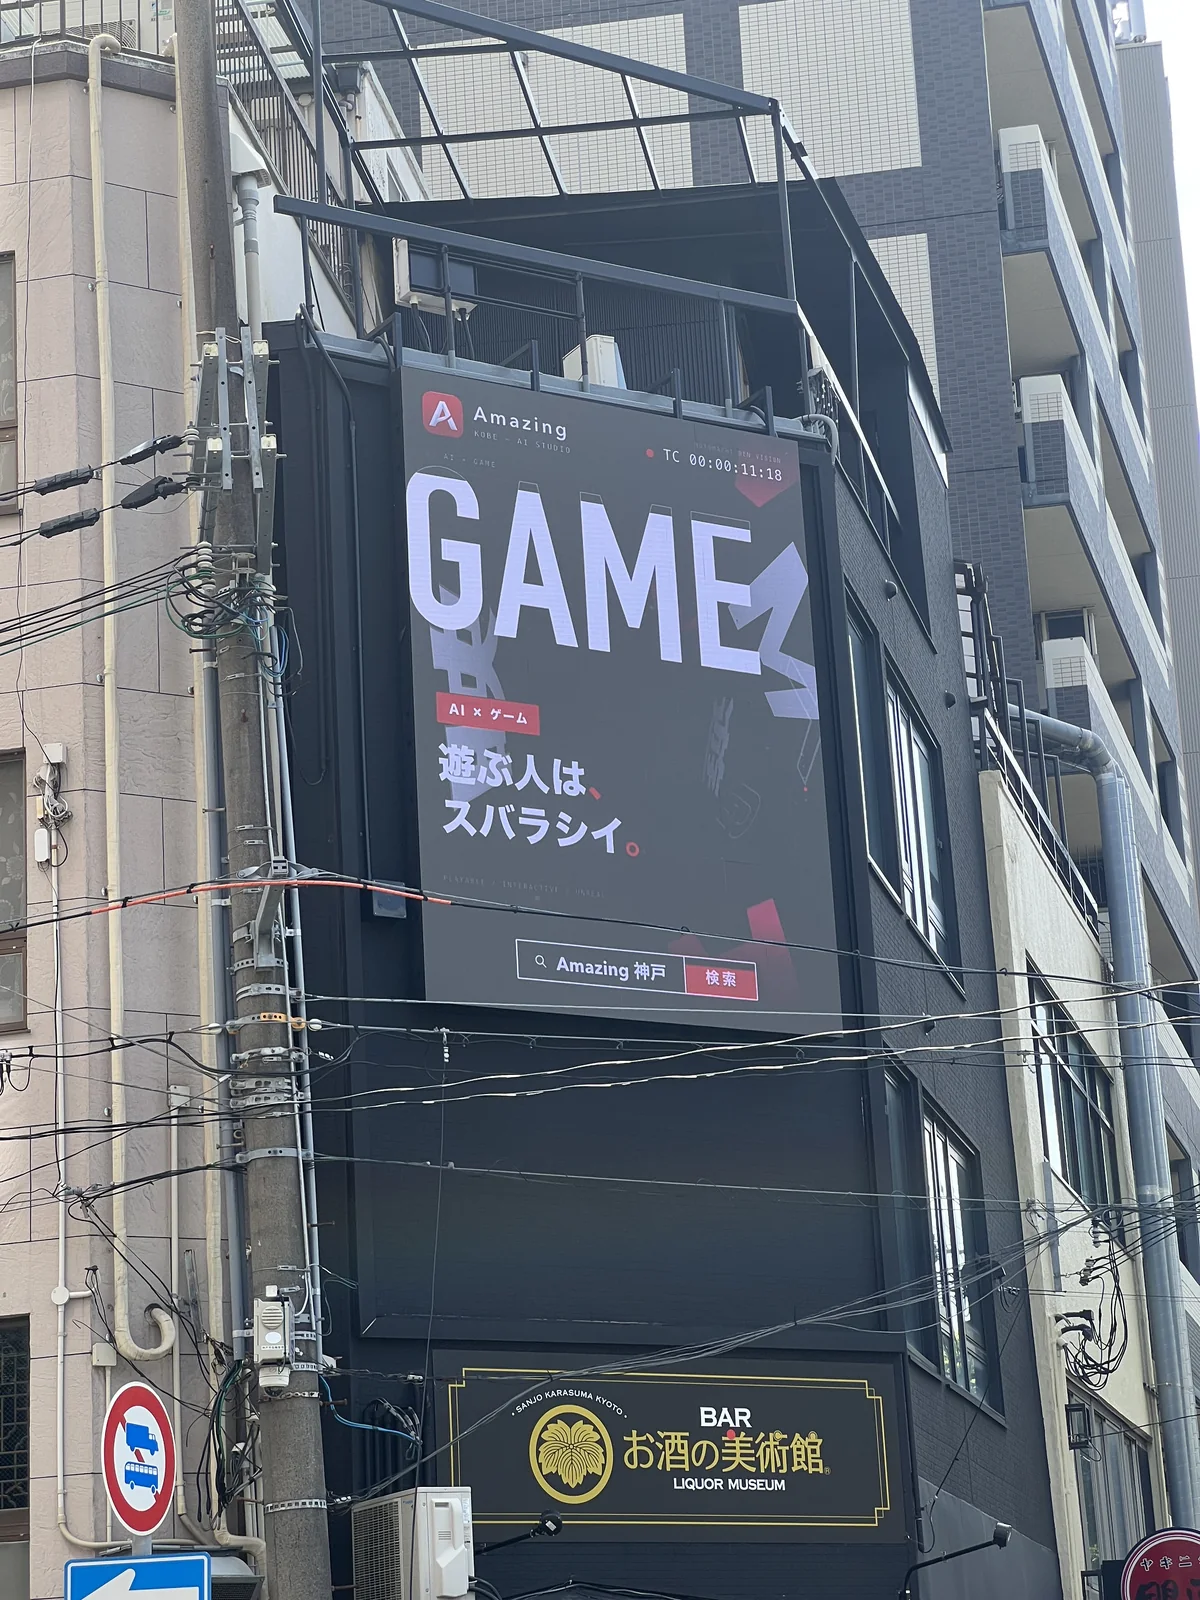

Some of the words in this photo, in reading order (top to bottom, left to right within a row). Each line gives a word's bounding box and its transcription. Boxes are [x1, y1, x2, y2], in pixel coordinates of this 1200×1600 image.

[473, 406, 568, 442] Amazing
[474, 430, 498, 441] KOBE
[517, 438, 529, 447] AI
[535, 441, 571, 454] STUDIO
[473, 458, 496, 468] GAME
[662, 448, 680, 463] TC
[689, 453, 783, 482] 00:00:11:18
[406, 467, 762, 675] GAME
[448, 703, 466, 717] AI
[490, 708, 528, 725] ゲーム
[438, 743, 601, 800] 遊ぶ人は、
[443, 799, 640, 857] スバラシイ。
[556, 956, 630, 982] Amazing
[633, 962, 666, 981] 神戸
[705, 970, 737, 988] 検索
[515, 1394, 543, 1414] SANJO
[544, 1389, 594, 1400] KARASUMA
[595, 1393, 624, 1416] KYOTO
[700, 1406, 752, 1428] BAR
[623, 1429, 824, 1474] お酒の美術館
[673, 1477, 724, 1491] LIQUOR
[728, 1478, 786, 1491] MUSEUM
[1140, 1555, 1200, 1571] ヤキニ
